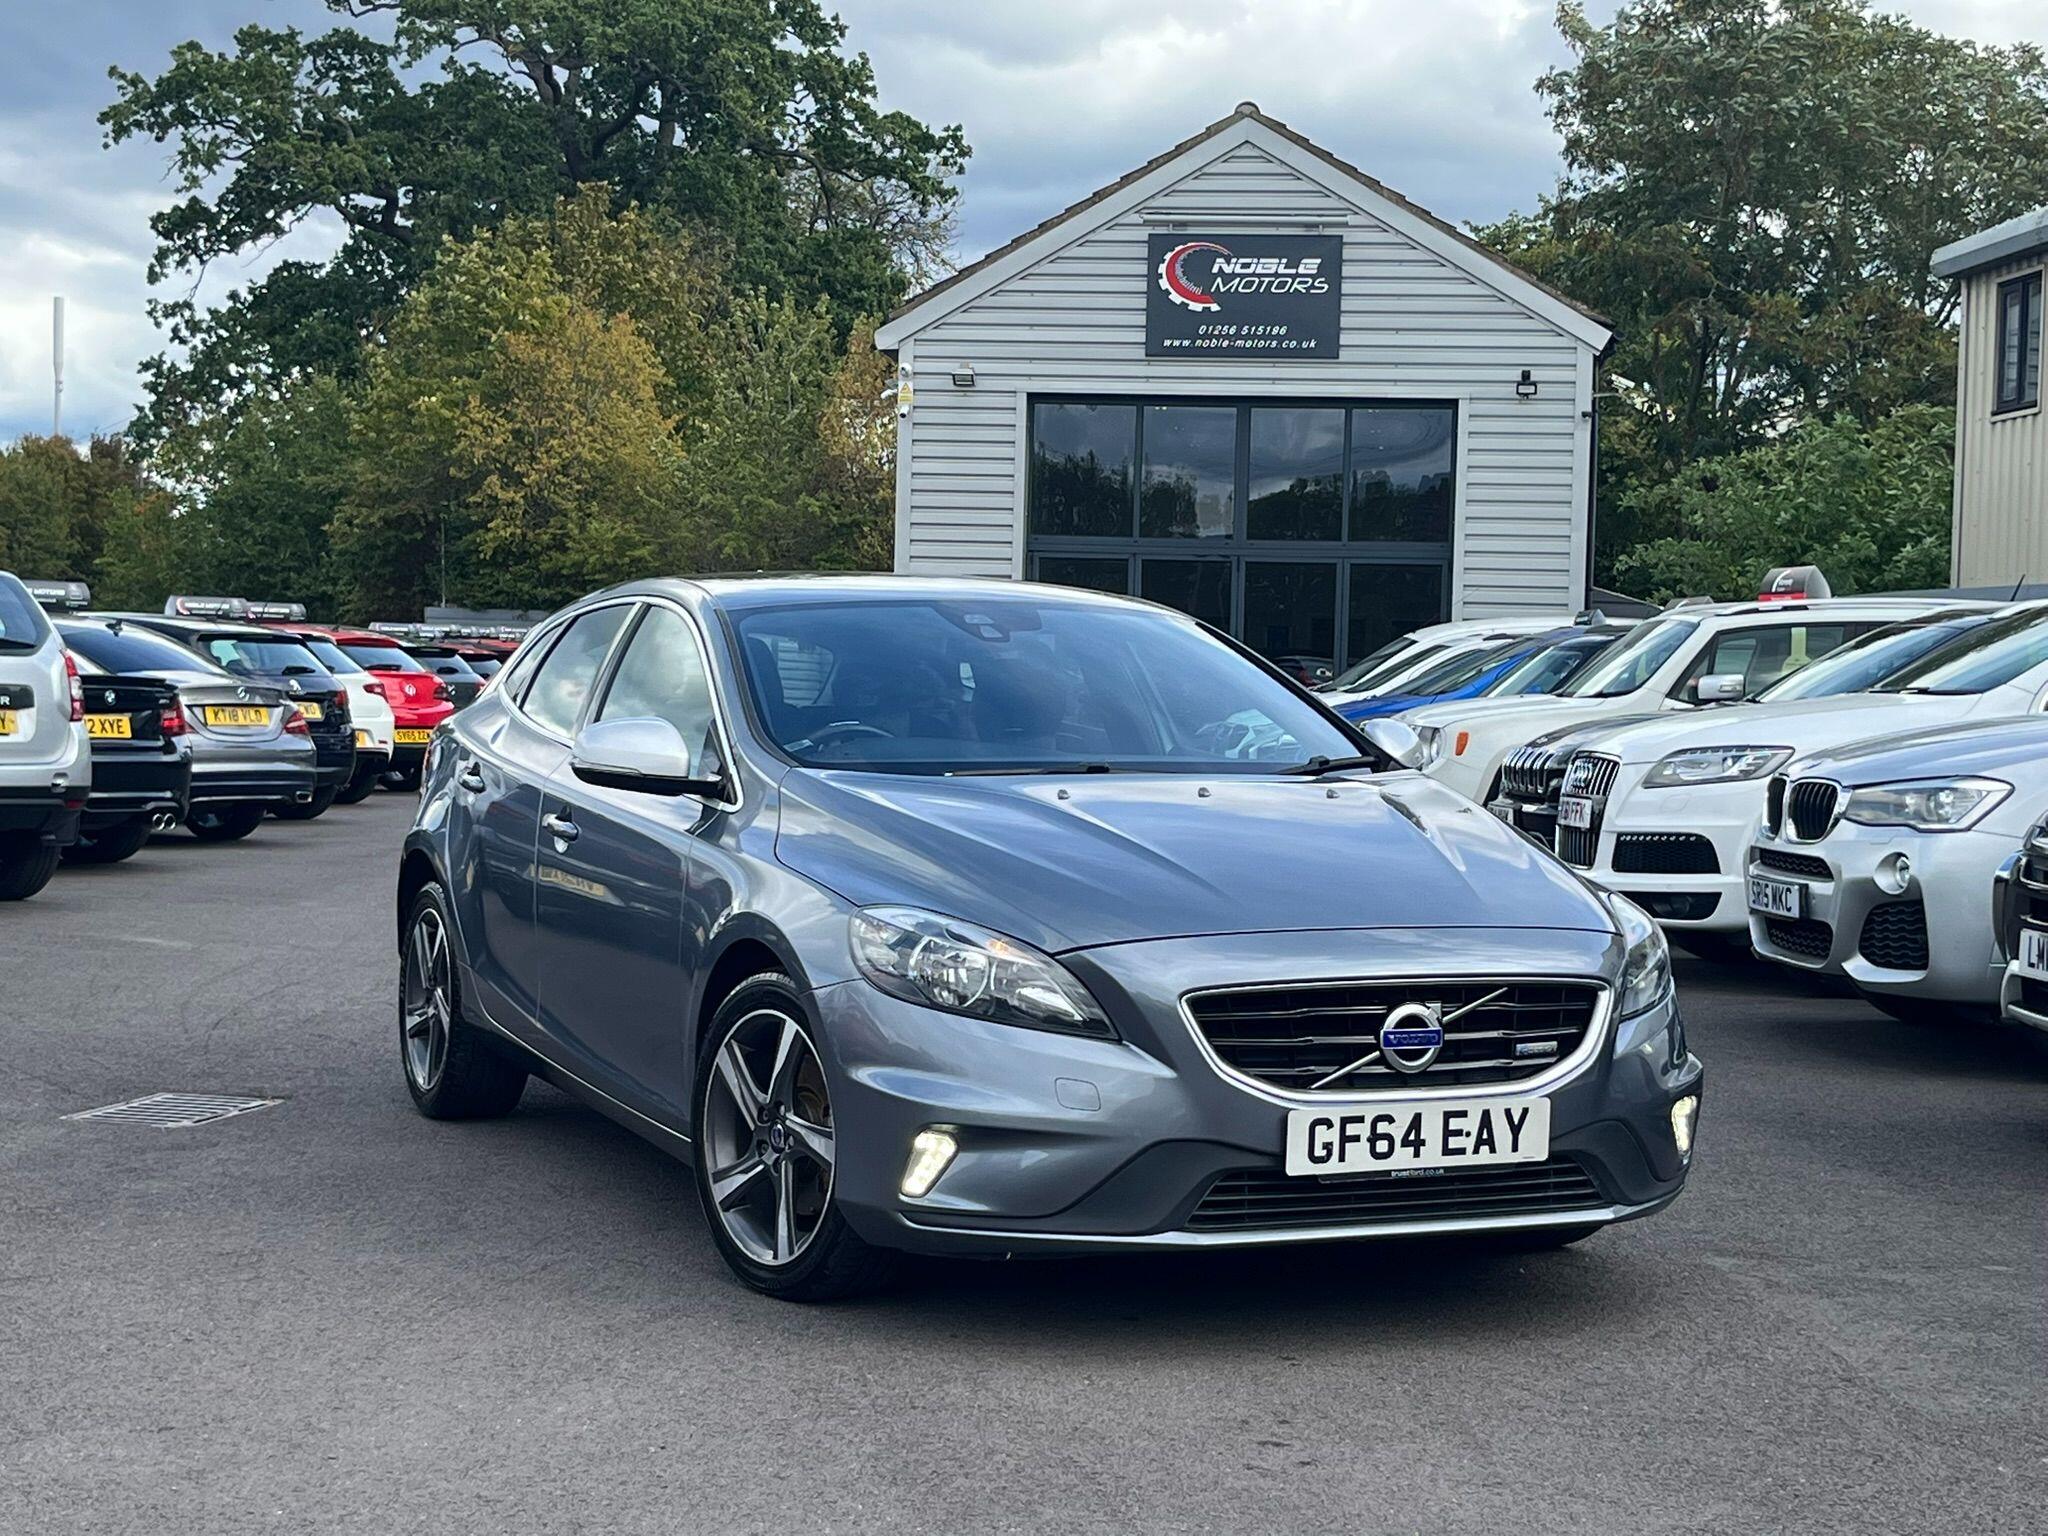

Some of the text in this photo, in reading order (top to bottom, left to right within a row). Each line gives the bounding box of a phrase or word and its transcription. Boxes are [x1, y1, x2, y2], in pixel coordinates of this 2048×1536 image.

[1211, 258, 1322, 274] NOBLE
[1210, 276, 1329, 294] MOTORS
[1198, 325, 1288, 336] 01256 515196
[1163, 338, 1317, 349] www.noble-motors.co.uk
[85, 718, 125, 734] 2 XYE
[1771, 883, 1792, 912] MKC
[1307, 1107, 1529, 1164] GF64 EAY
